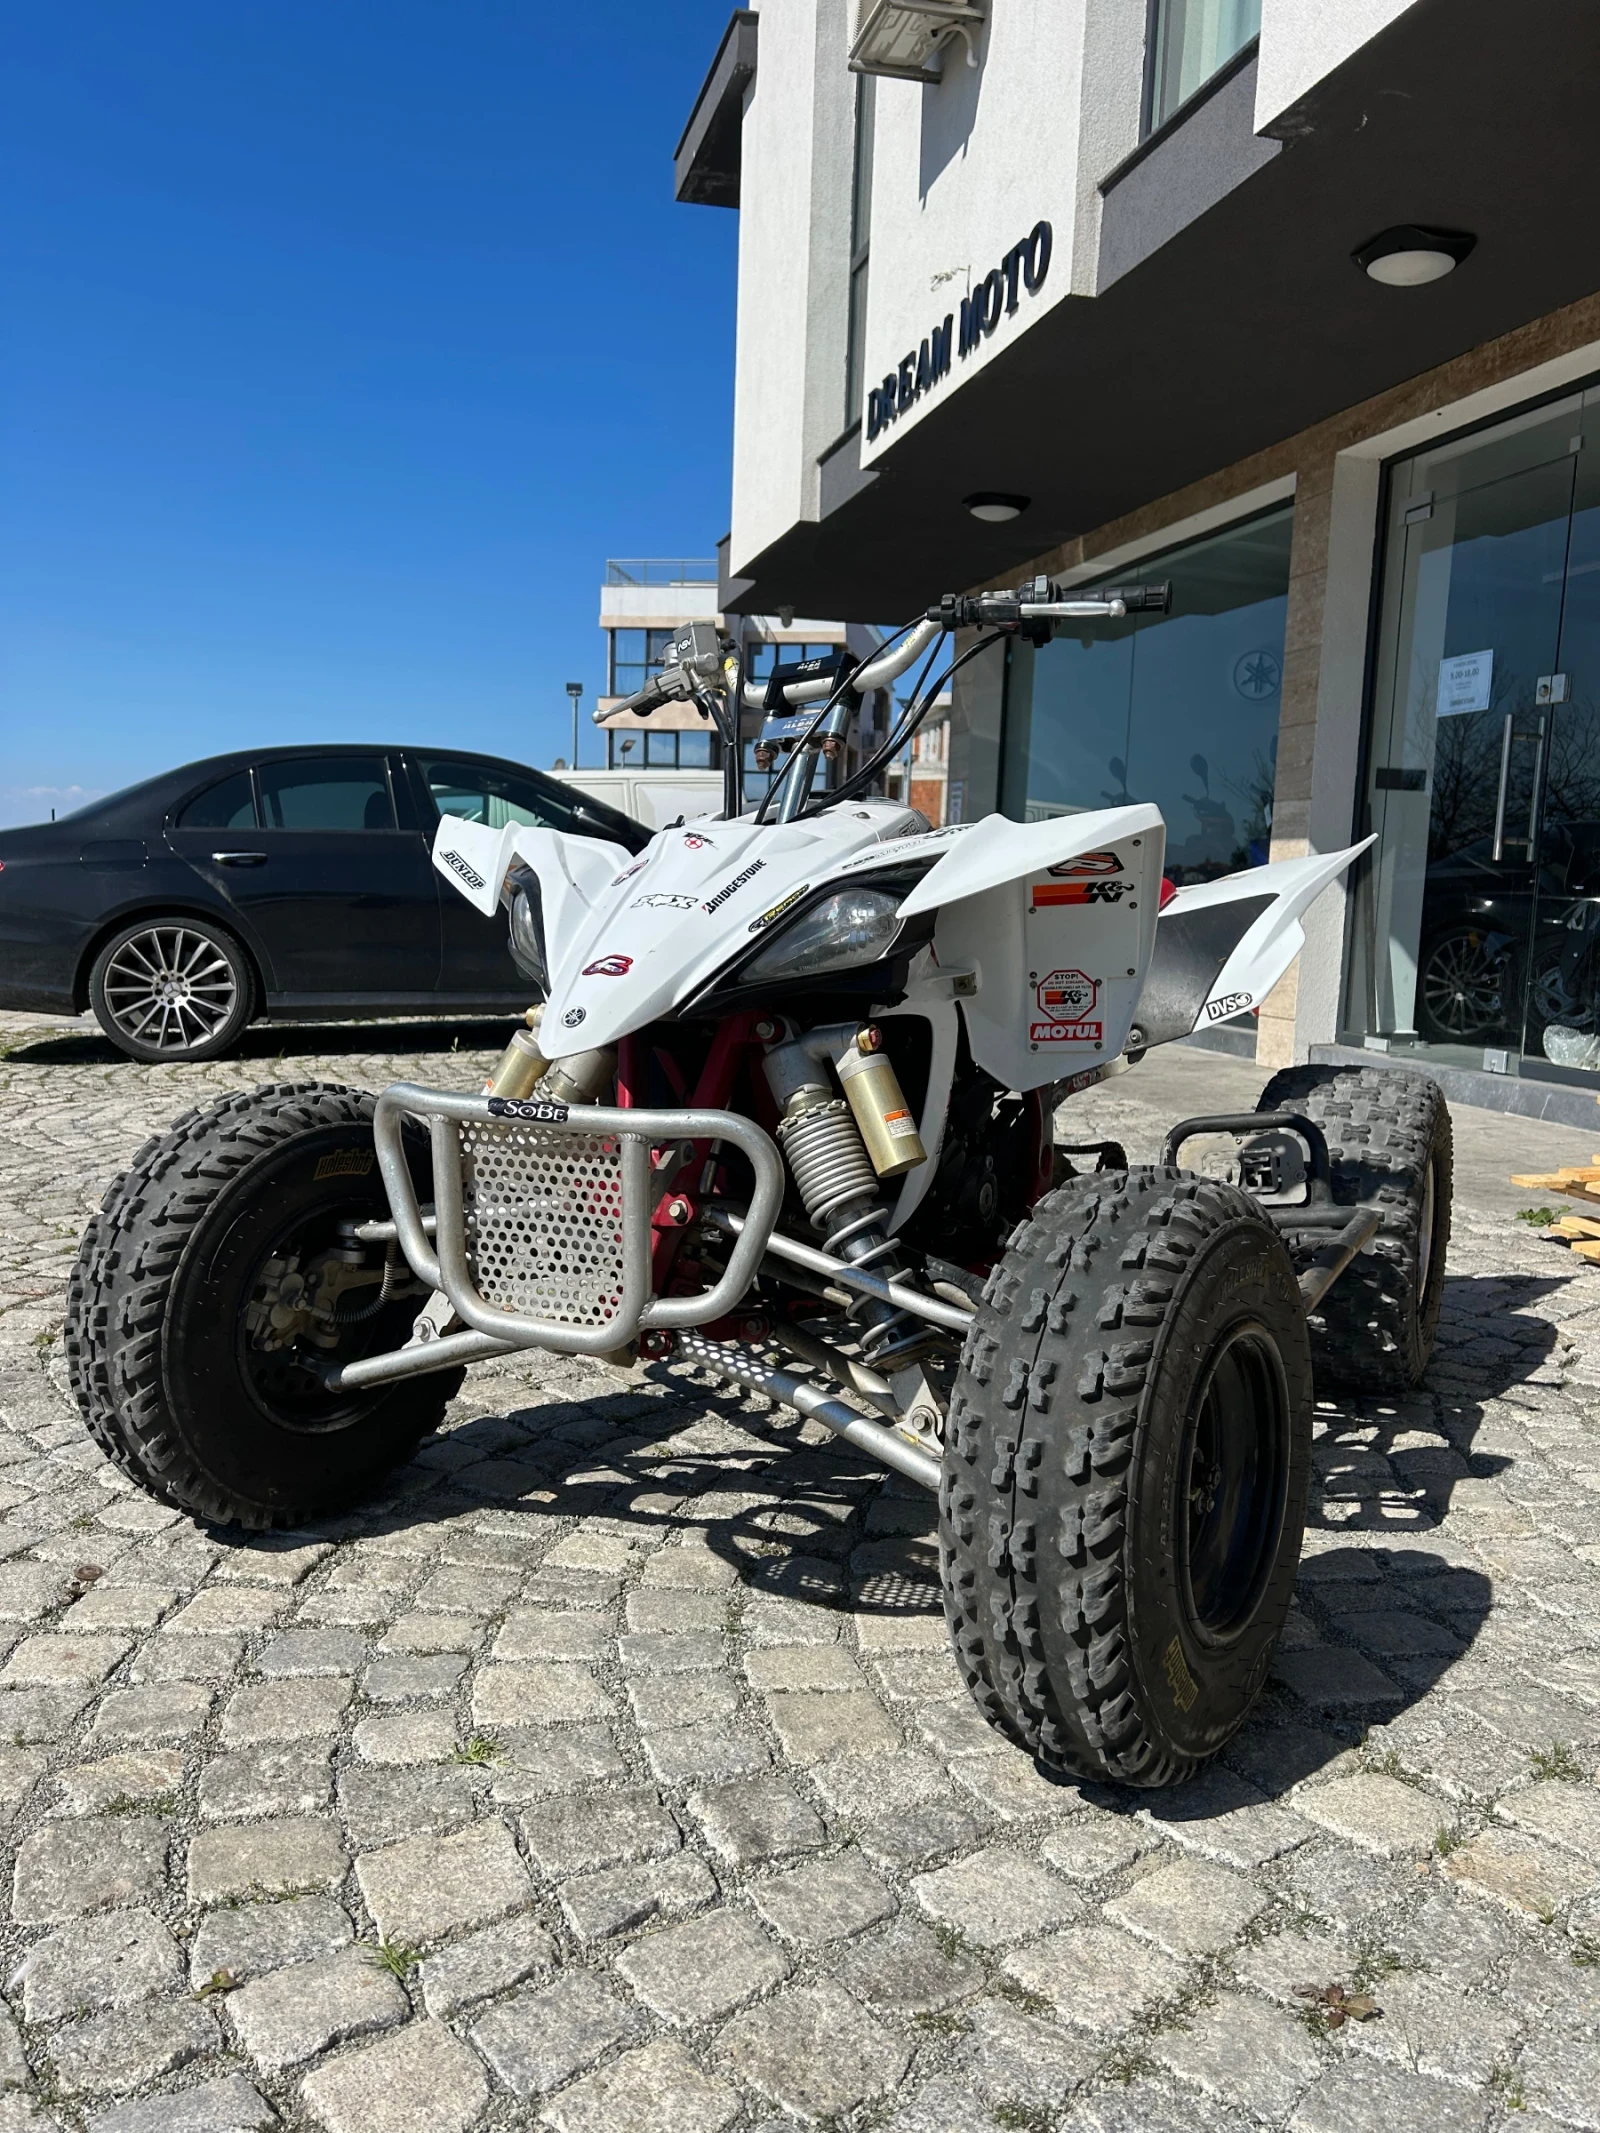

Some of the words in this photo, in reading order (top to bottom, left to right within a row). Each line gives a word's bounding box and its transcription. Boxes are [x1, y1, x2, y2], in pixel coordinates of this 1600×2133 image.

[867, 313, 954, 441] DREAM
[958, 220, 1053, 358] MOTO
[443, 851, 485, 889] DUNLOP
[702, 859, 767, 915] BRIDGESTONE
[1083, 881, 1135, 903] K&N
[1061, 990, 1089, 1004] K&N
[1208, 998, 1237, 1019] DVS
[1033, 1025, 1099, 1038] MOTUL
